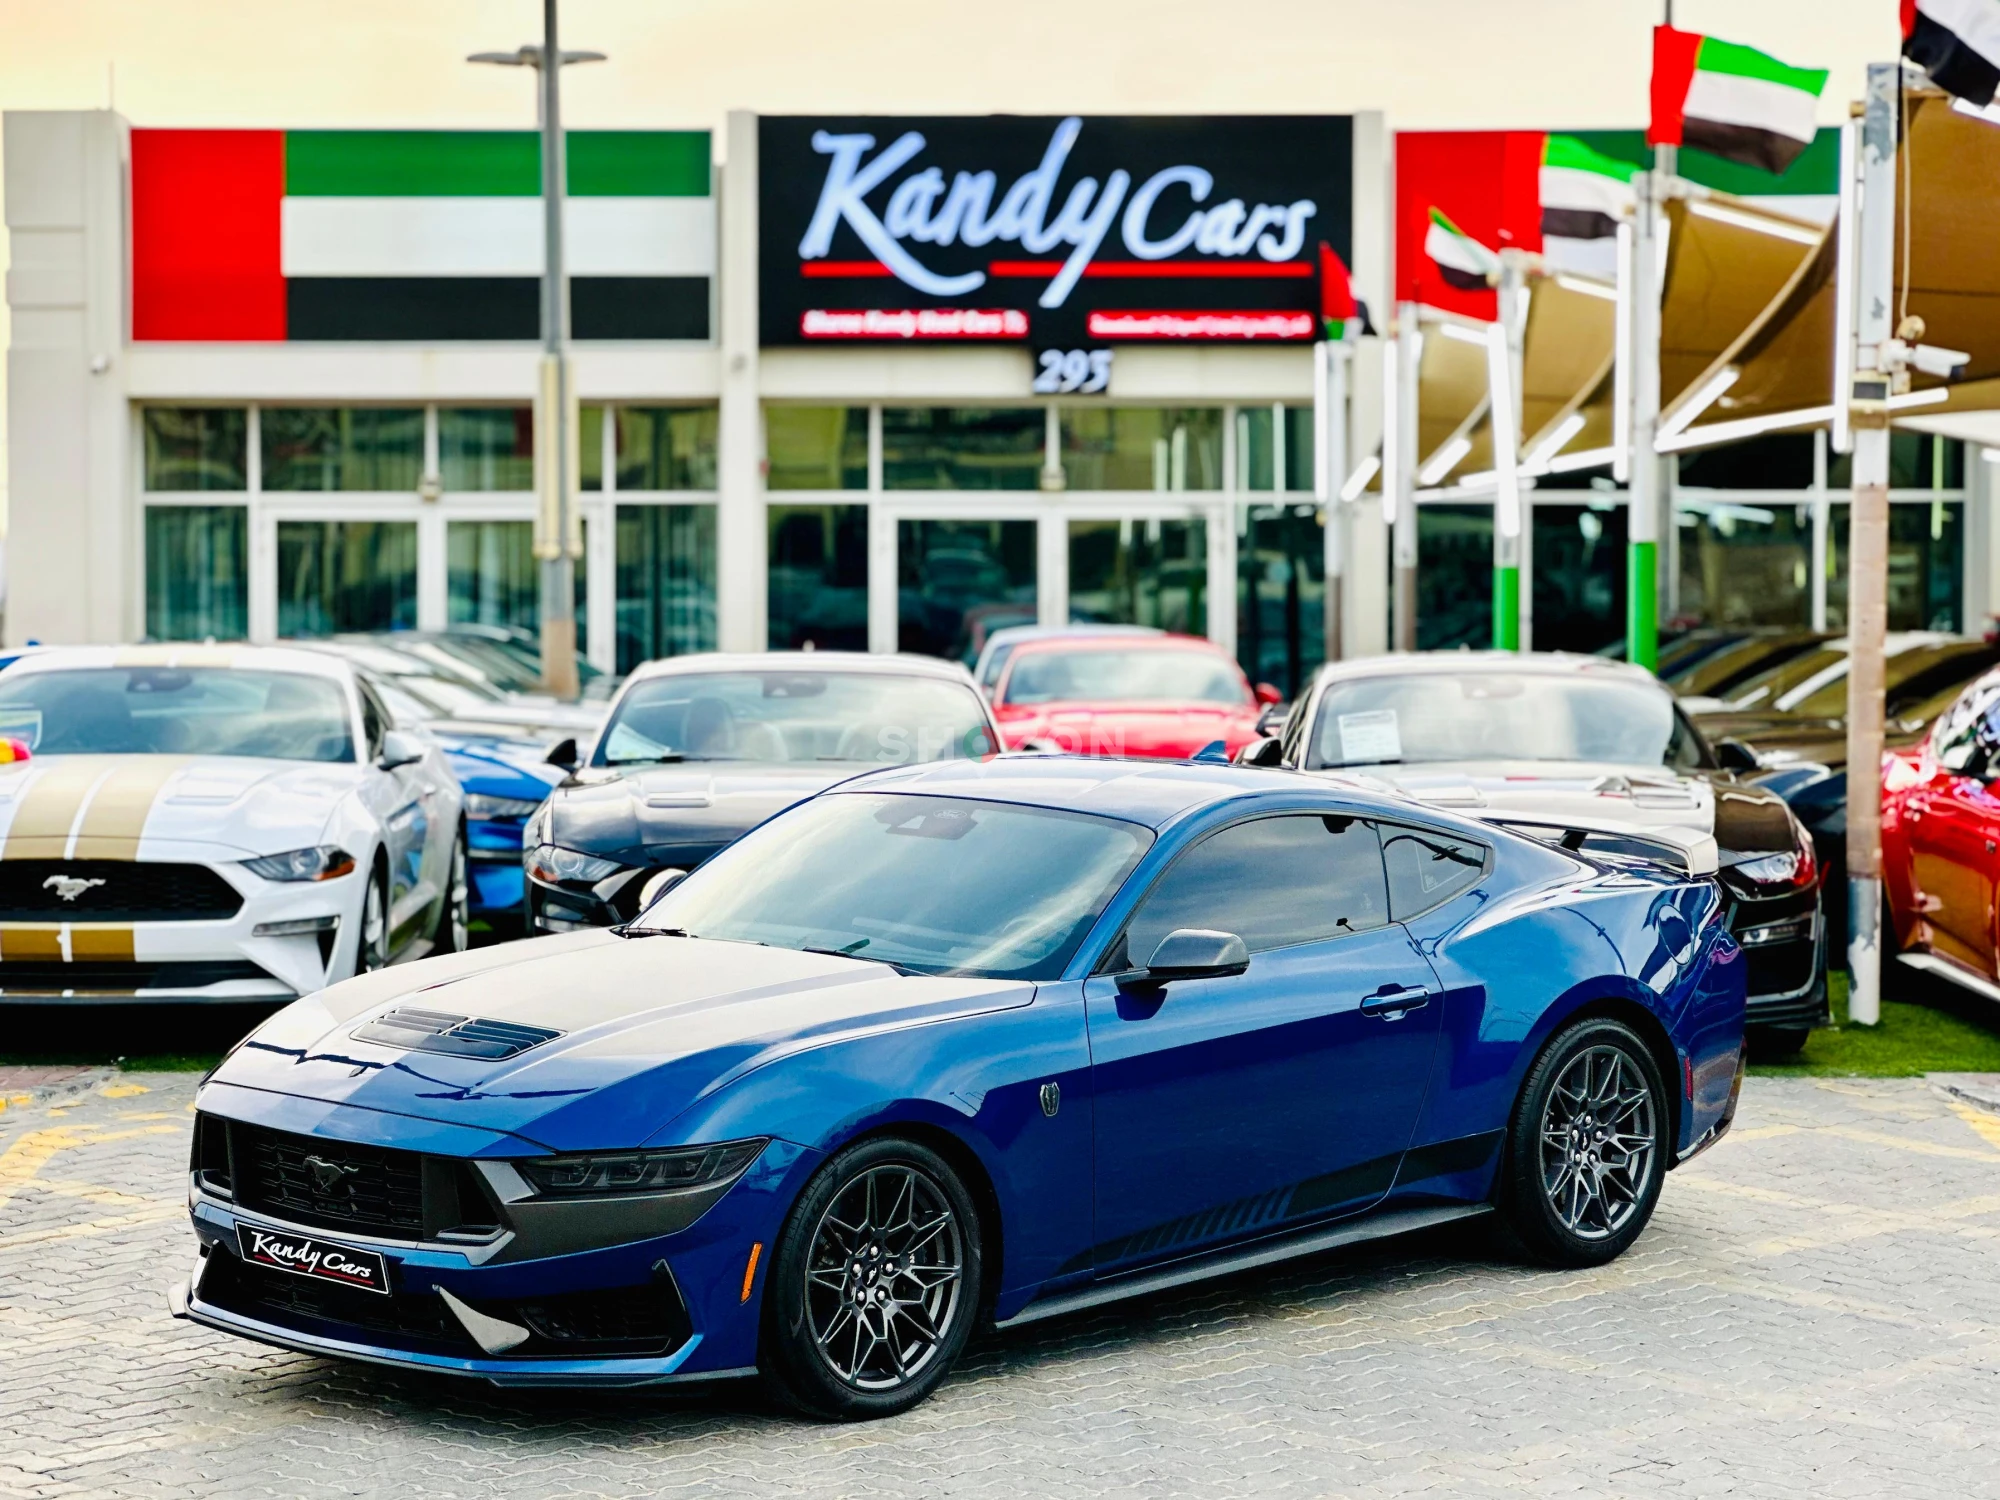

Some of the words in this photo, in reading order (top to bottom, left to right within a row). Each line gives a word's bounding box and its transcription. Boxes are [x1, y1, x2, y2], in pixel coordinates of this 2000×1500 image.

[799, 116, 1131, 308] Kandy
[1122, 165, 1317, 262] Cars
[1033, 348, 1113, 393] 295
[251, 1231, 321, 1272] Kandy
[322, 1253, 371, 1277] Cars
